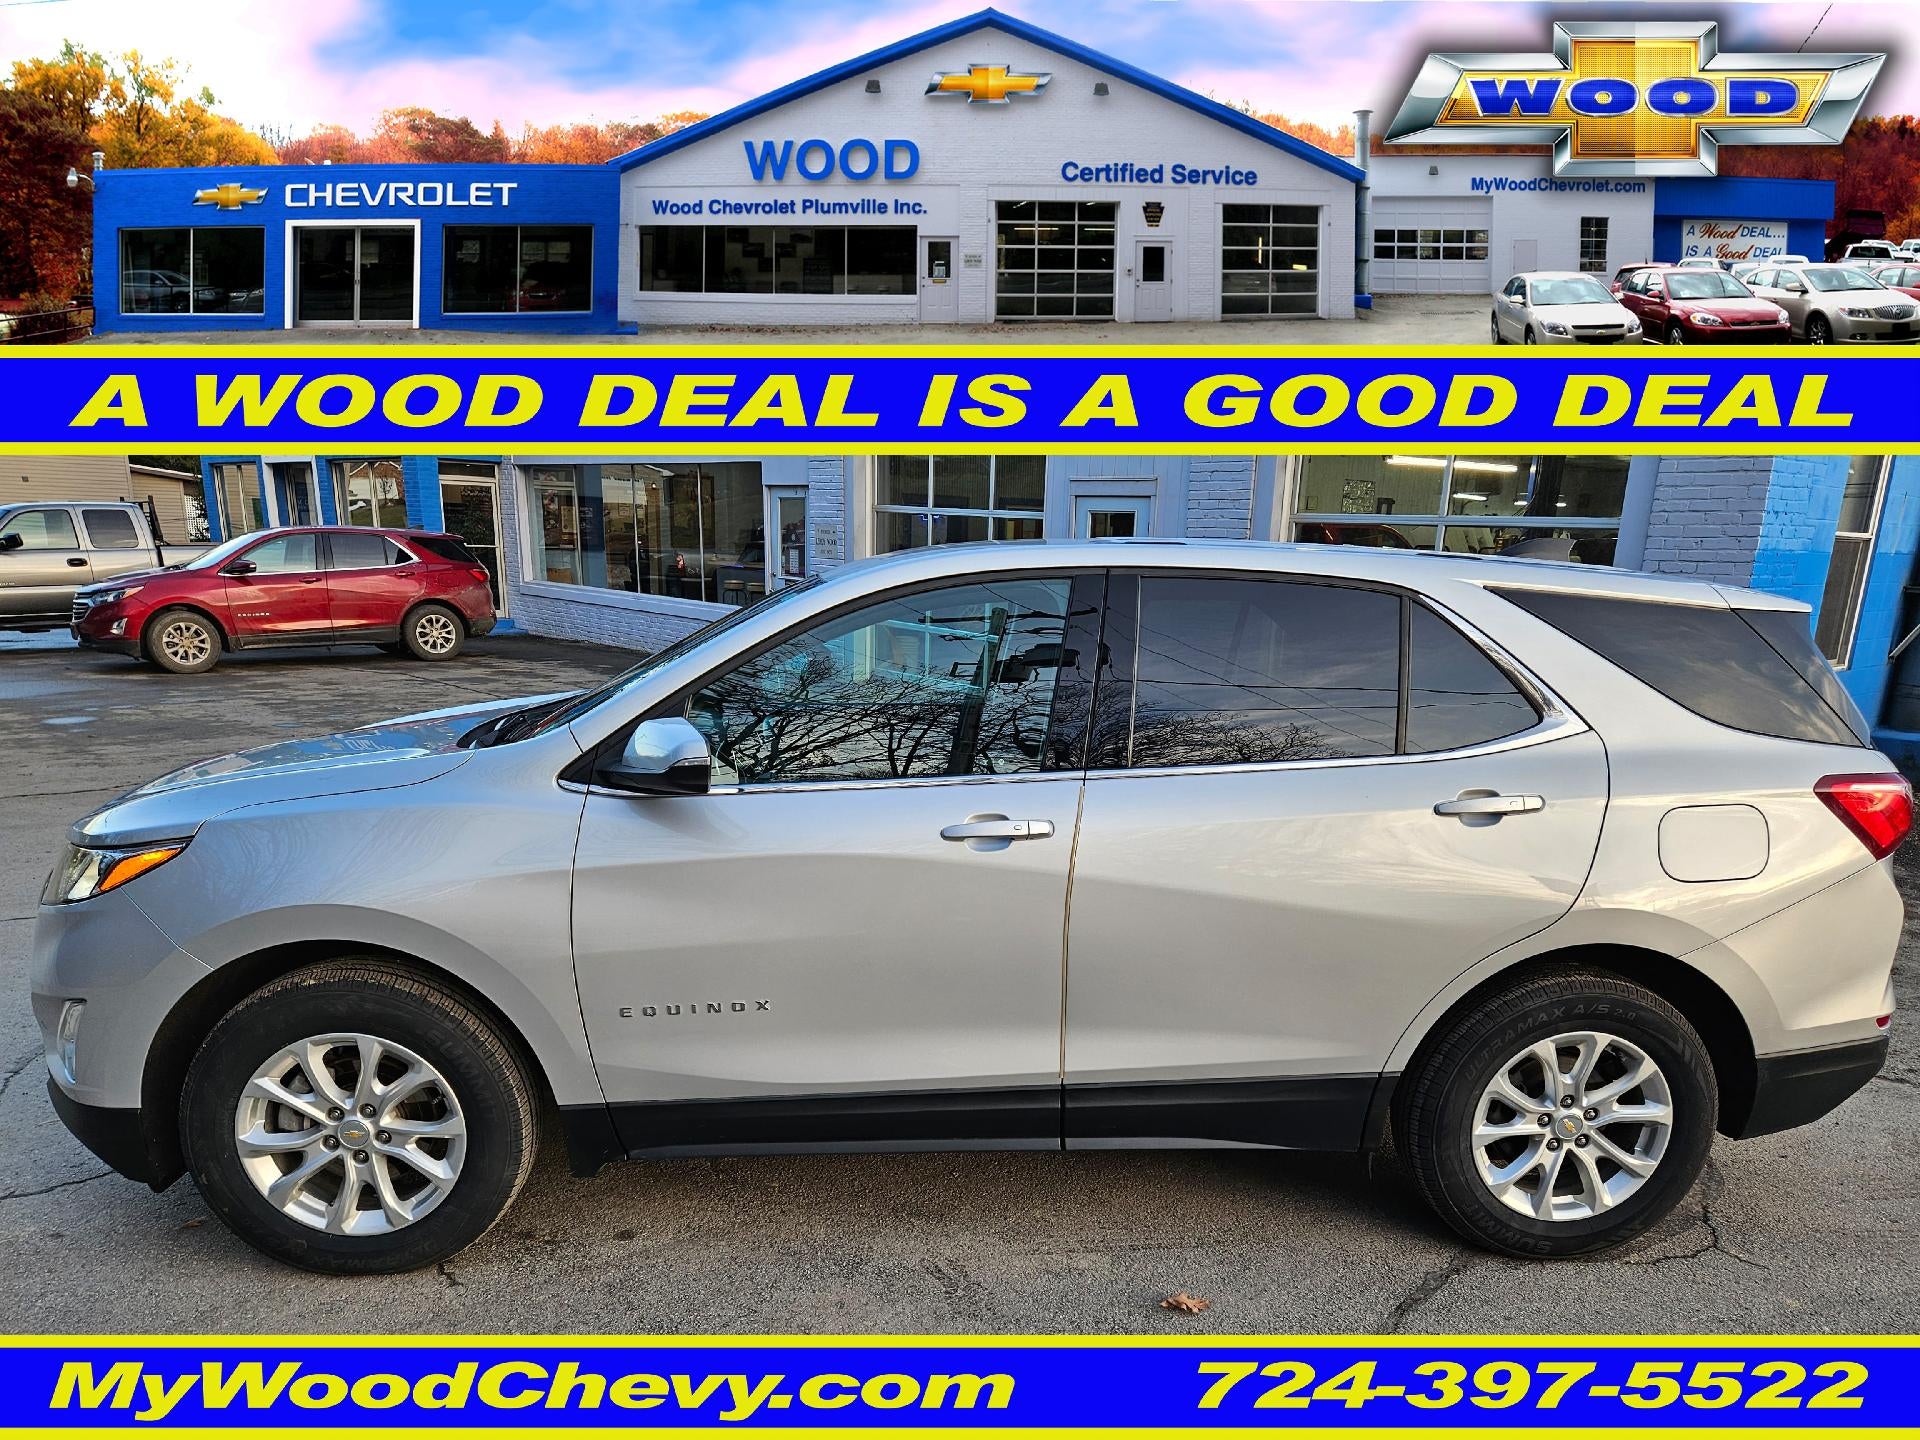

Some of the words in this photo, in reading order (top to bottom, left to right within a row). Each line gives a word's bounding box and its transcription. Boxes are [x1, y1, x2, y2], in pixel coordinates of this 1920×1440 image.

[743, 138, 921, 181] WOOD
[1061, 161, 1164, 183] Certified
[1170, 164, 1259, 186] Service
[284, 182, 518, 207] CHEVROLET
[1470, 177, 1647, 195] MyWoodChevrolet.com
[652, 199, 702, 215] Wood
[708, 198, 796, 215] Chevrolet
[802, 198, 889, 215] Plumville
[894, 198, 928, 215] Inc.
[1686, 224, 1696, 236] A
[1699, 222, 1744, 240] Wood
[1740, 225, 1785, 239] DEAL...
[1685, 244, 1699, 257] IS
[1703, 245, 1712, 257] A
[1715, 243, 1755, 260] Good
[619, 1000, 770, 1018] EQUINOX
[1465, 1005, 1567, 1081] ULTRAMAX
[1574, 1003, 1611, 1016] A/S
